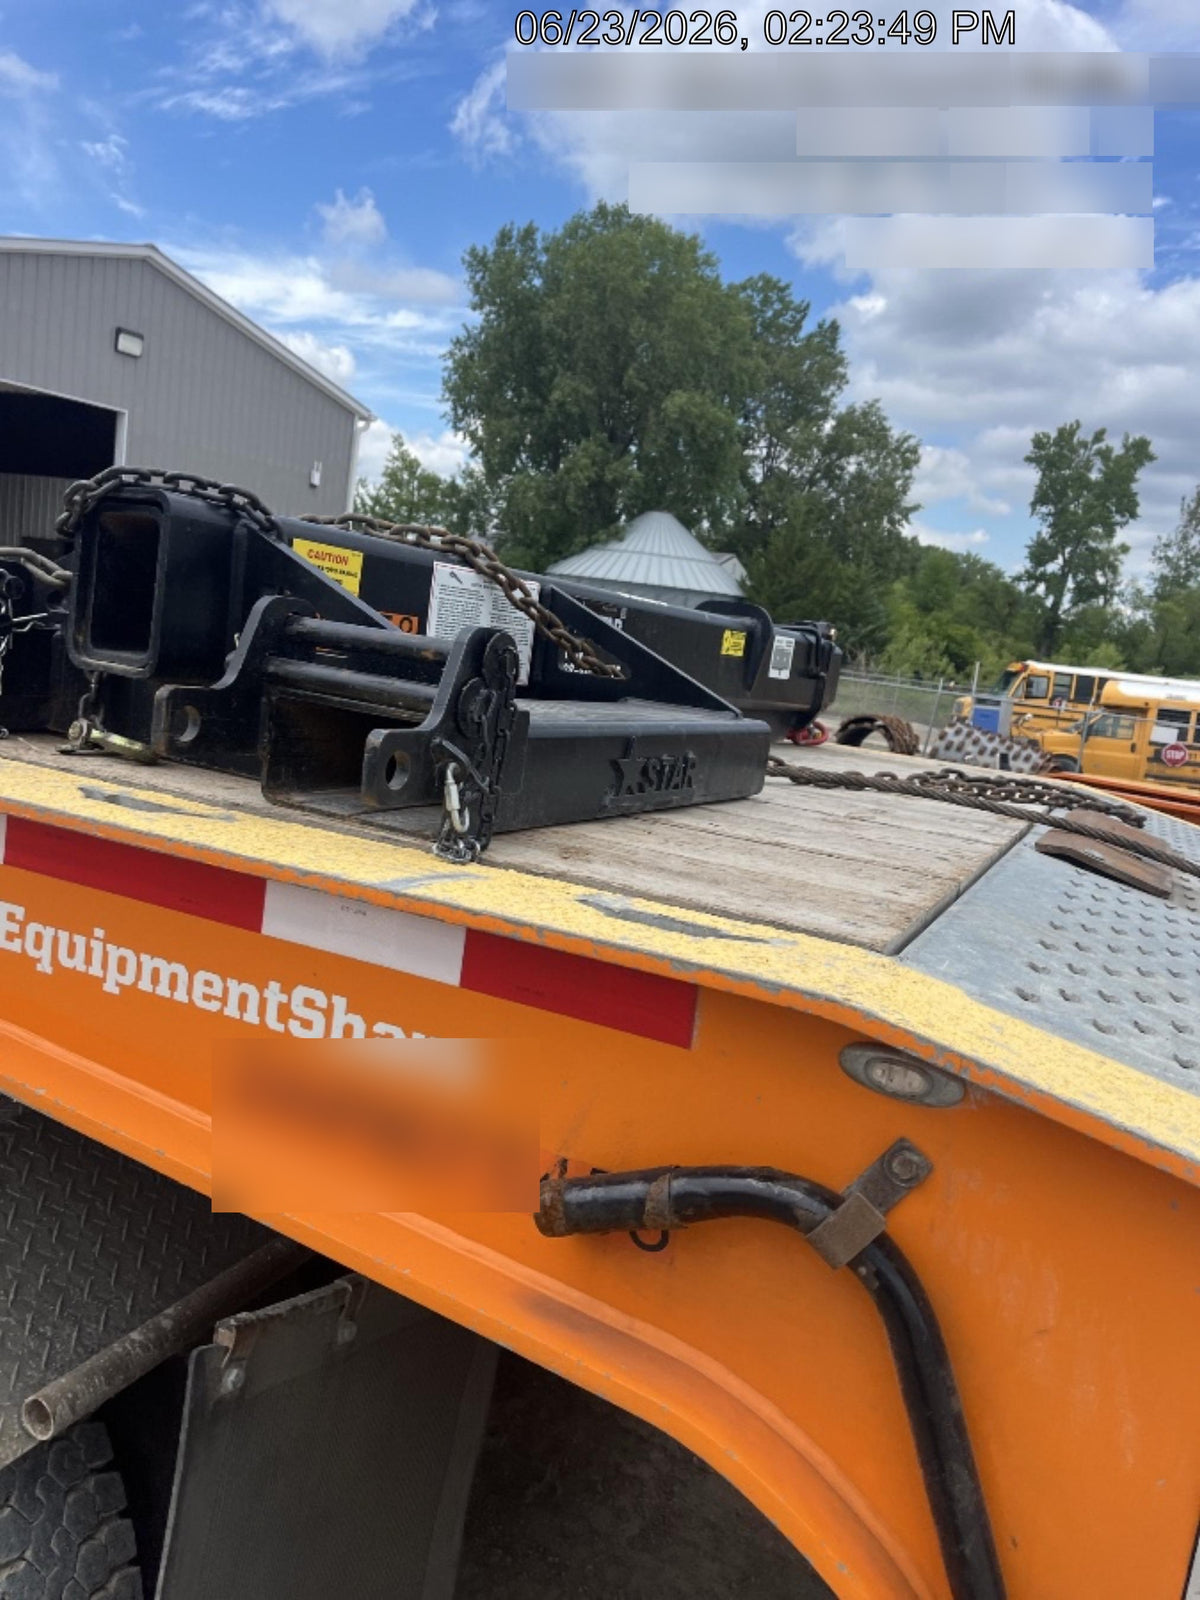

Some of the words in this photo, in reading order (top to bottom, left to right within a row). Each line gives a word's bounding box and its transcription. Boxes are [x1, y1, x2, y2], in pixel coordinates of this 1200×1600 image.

[307, 548, 350, 567] CAUTION
[1165, 749, 1186, 760] STOP
[0, 900, 437, 1039] EquipmentSh
